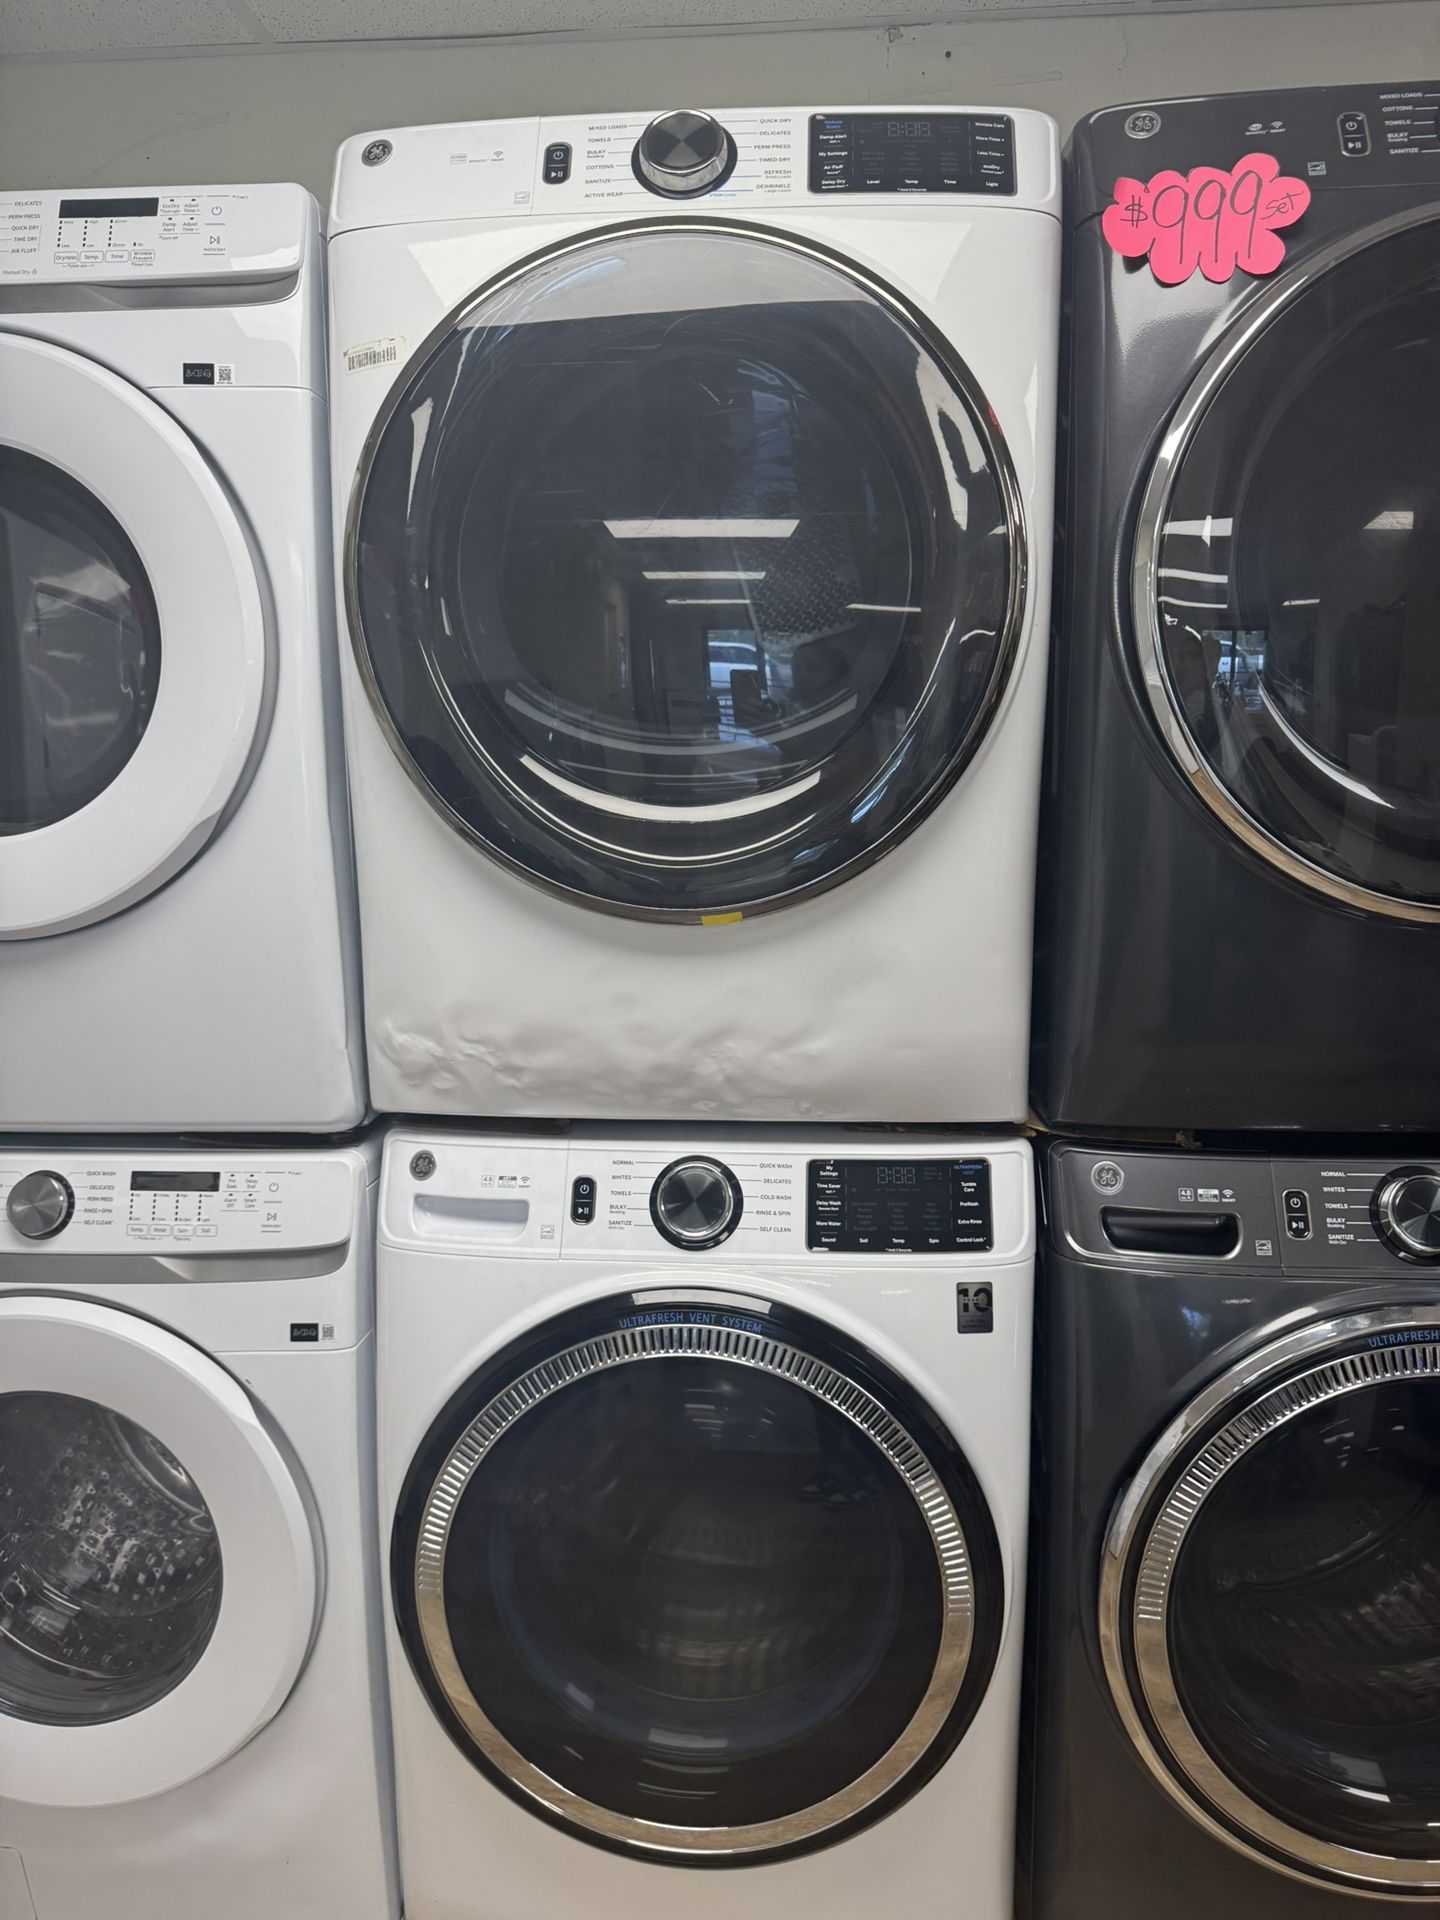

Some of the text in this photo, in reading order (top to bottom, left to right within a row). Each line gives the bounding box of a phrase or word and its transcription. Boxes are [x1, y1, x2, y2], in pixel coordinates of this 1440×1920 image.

[619, 1312, 762, 1333] ULTRAFRESH VENT SYSTEM
[1368, 1330, 1439, 1348] ULTRAFRESH
